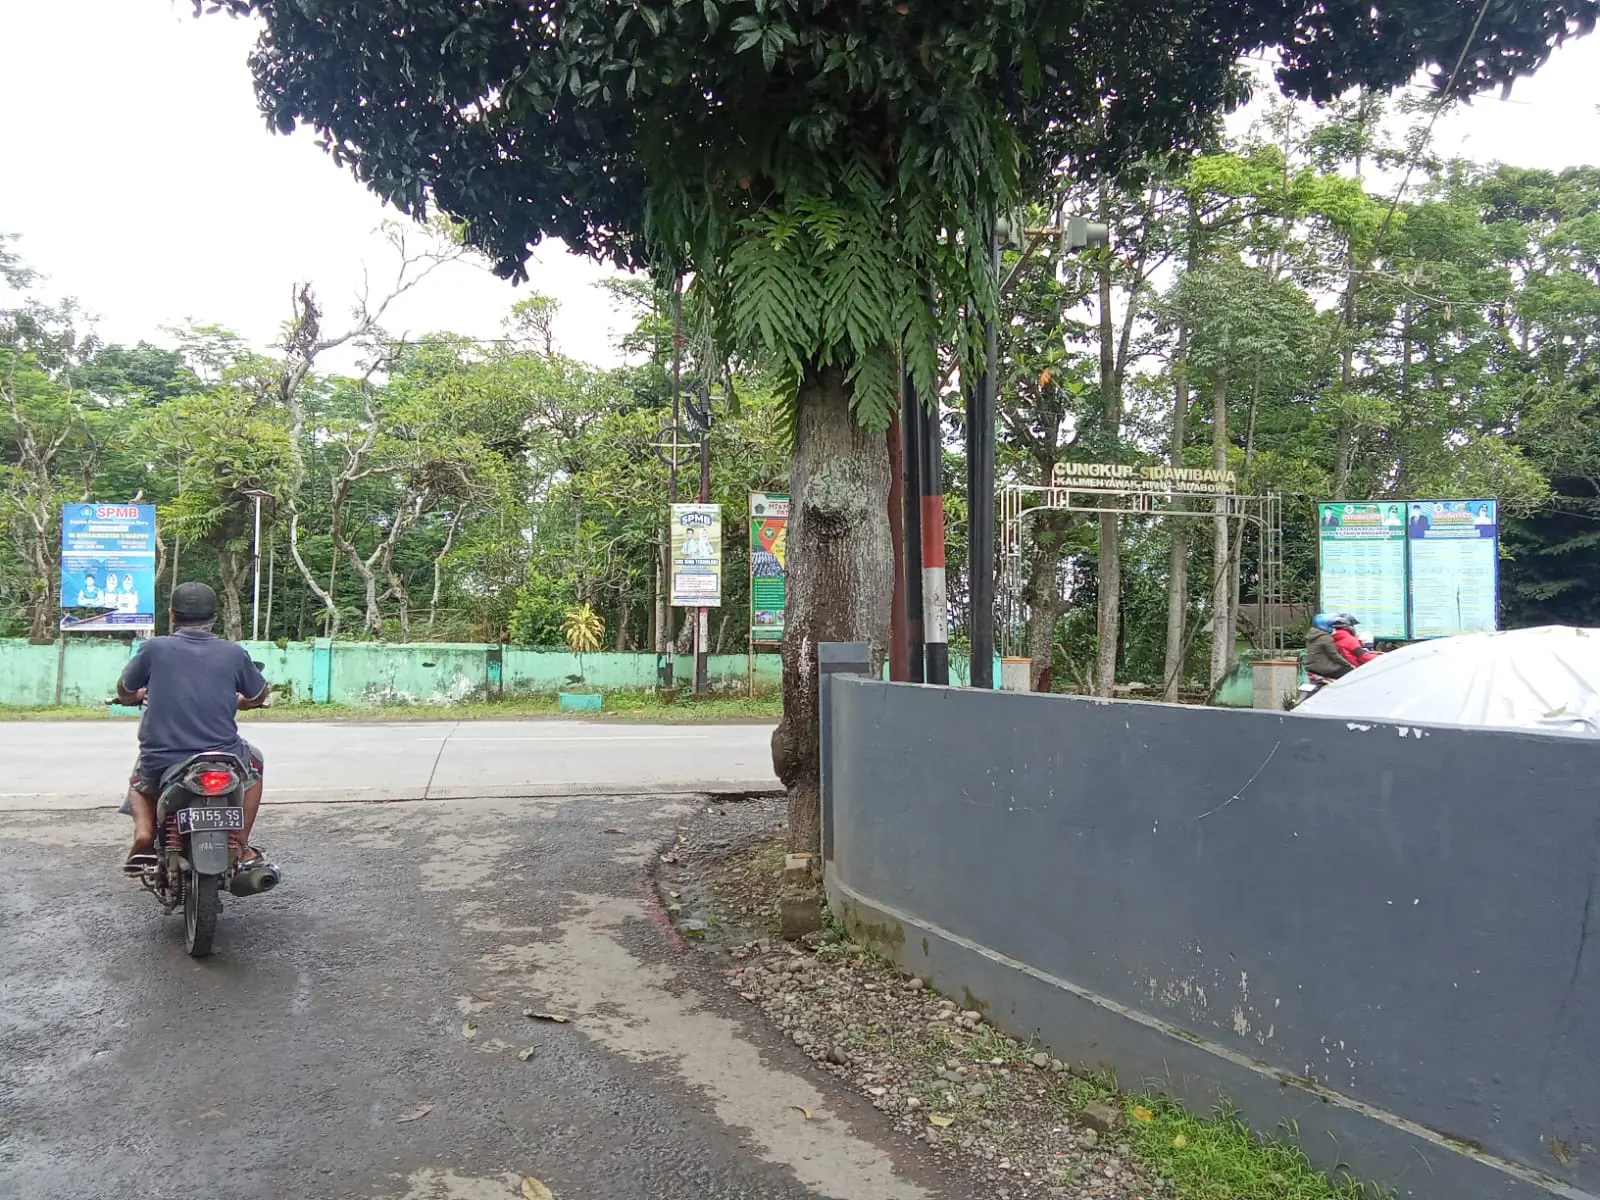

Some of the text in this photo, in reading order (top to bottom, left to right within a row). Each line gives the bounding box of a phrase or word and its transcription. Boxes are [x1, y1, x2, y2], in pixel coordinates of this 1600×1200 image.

[1053, 462, 1236, 482] CUNGKUP SIDAWIBAWA
[97, 507, 138, 518] SPMB
[681, 513, 712, 525] SPMB
[180, 812, 187, 824] R
[225, 810, 240, 820] SS
